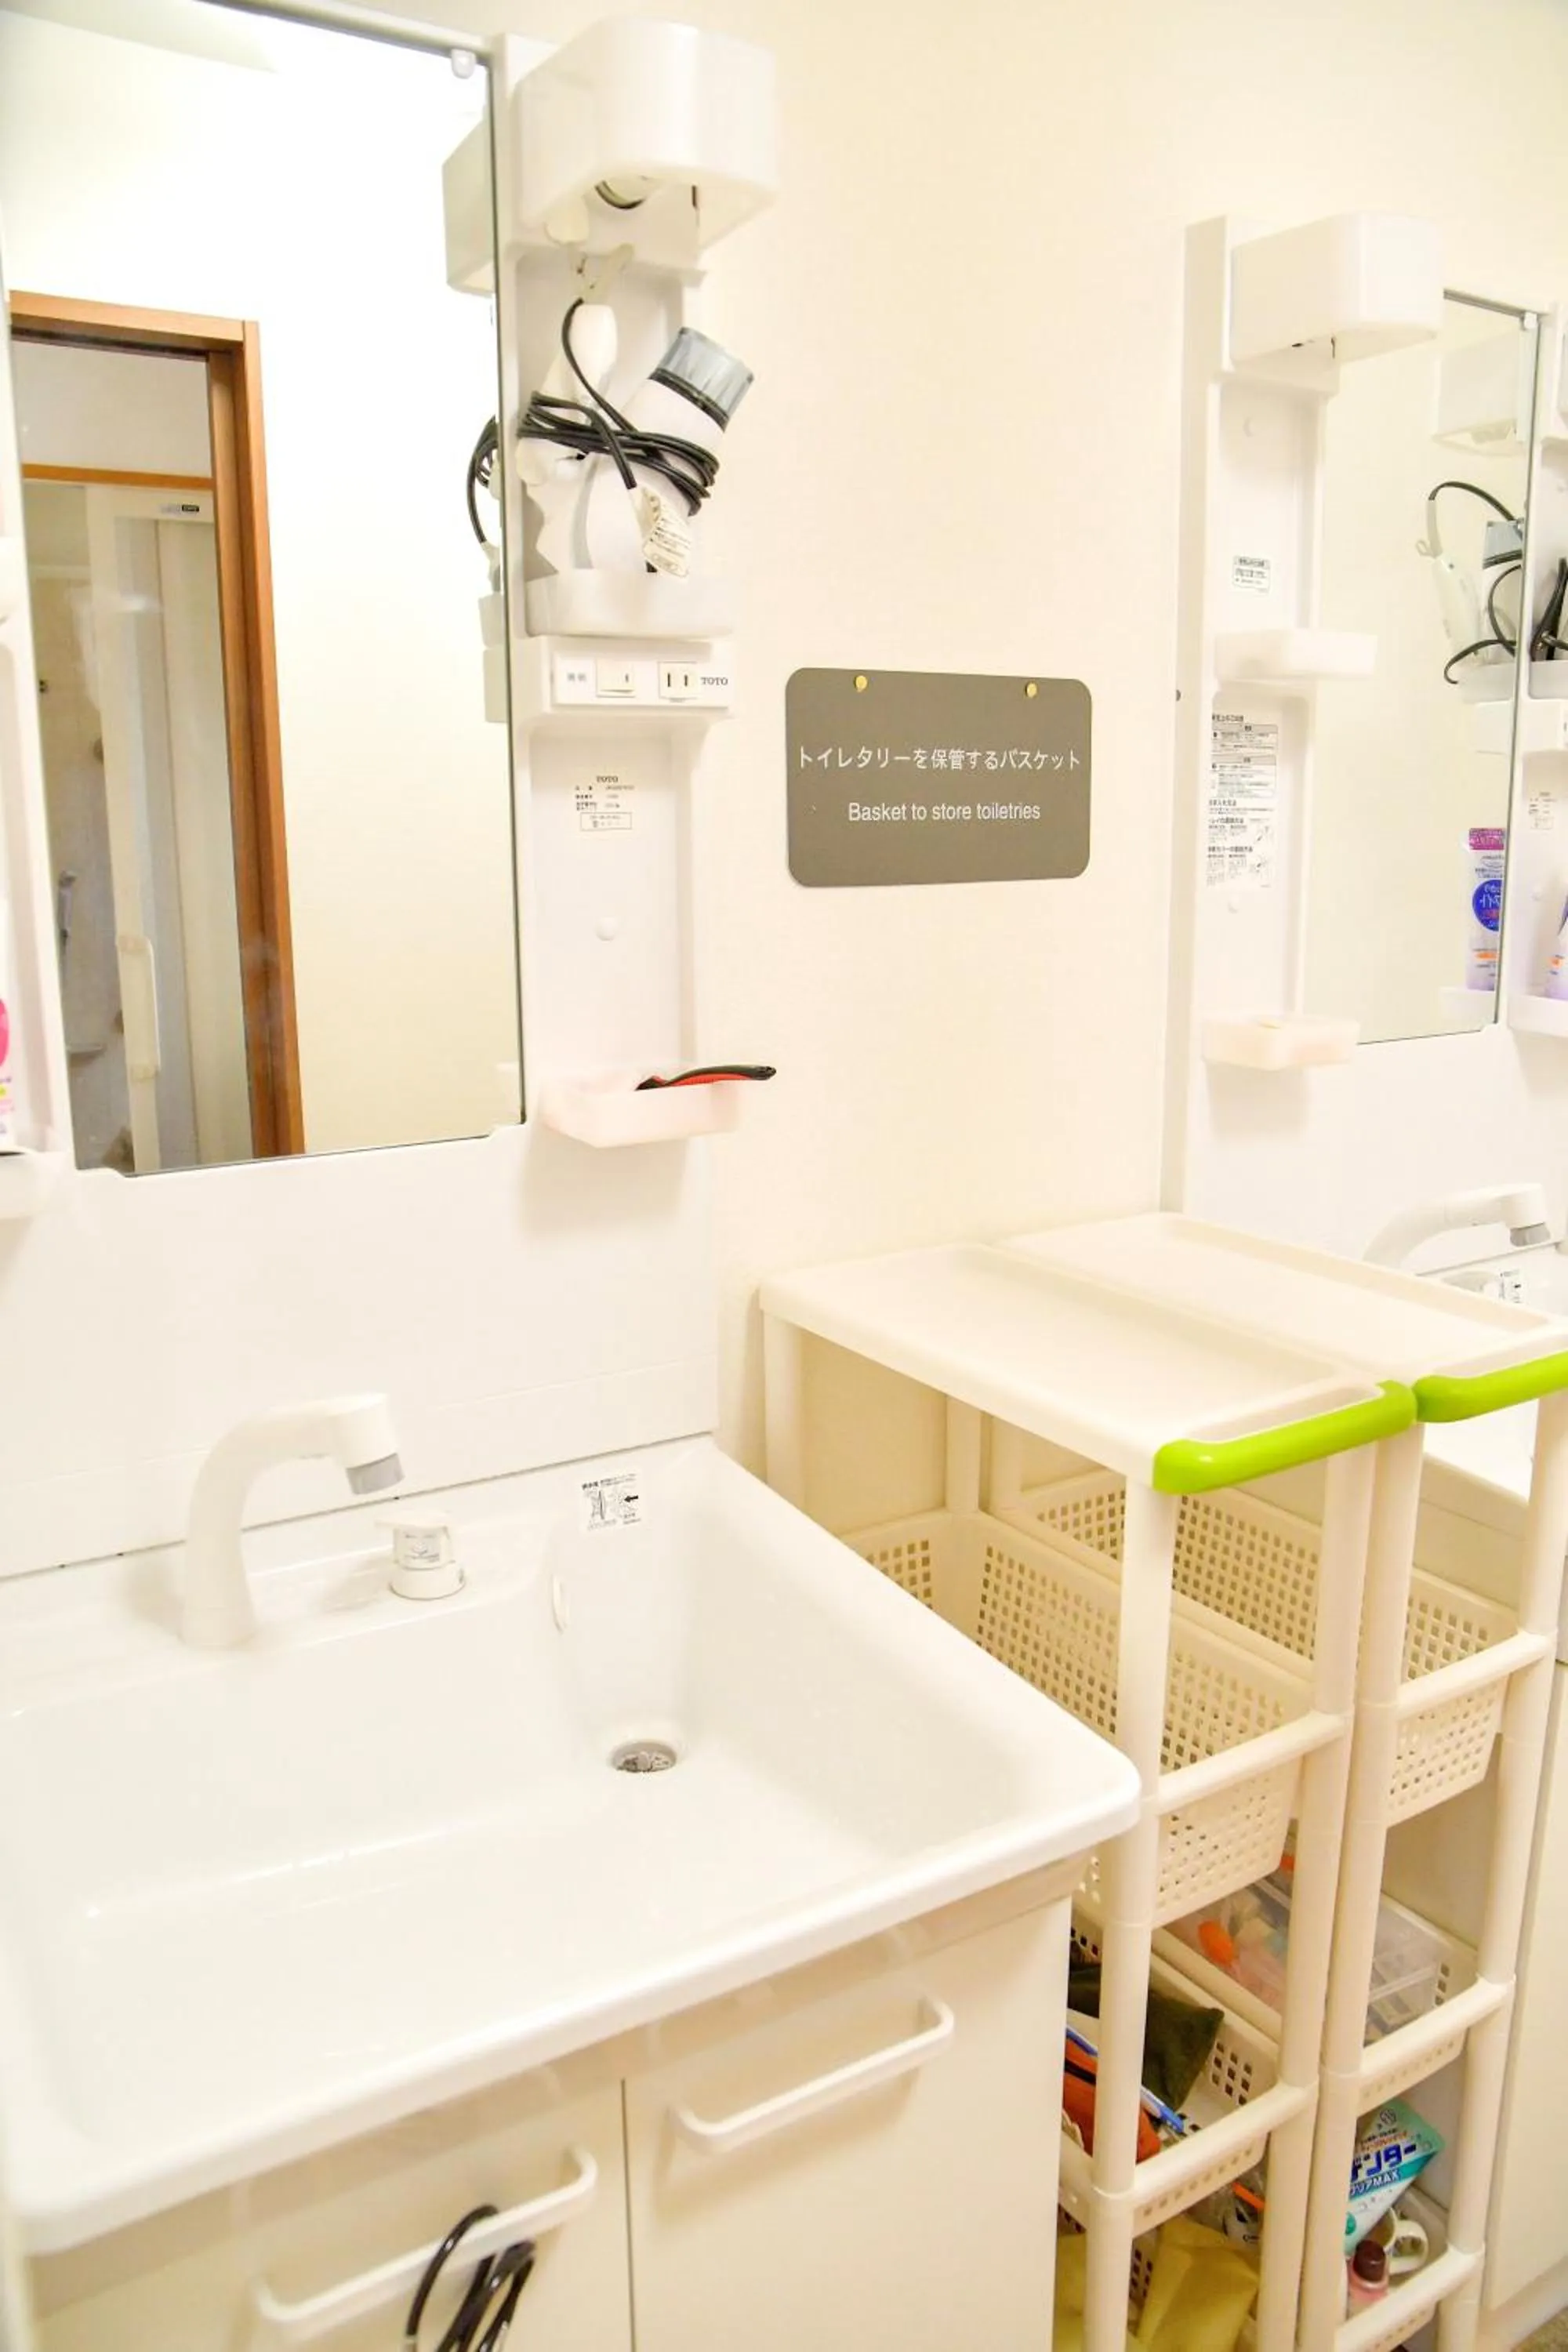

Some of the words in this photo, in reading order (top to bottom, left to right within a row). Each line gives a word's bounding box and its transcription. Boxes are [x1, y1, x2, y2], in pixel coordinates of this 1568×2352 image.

[700, 676, 729, 686] TOTO
[800, 746, 1080, 770] トイレタリーを保管するバスケット
[848, 802, 907, 821] Basket
[911, 803, 927, 821] to
[932, 803, 972, 821] store
[976, 802, 1041, 821] toiletries
